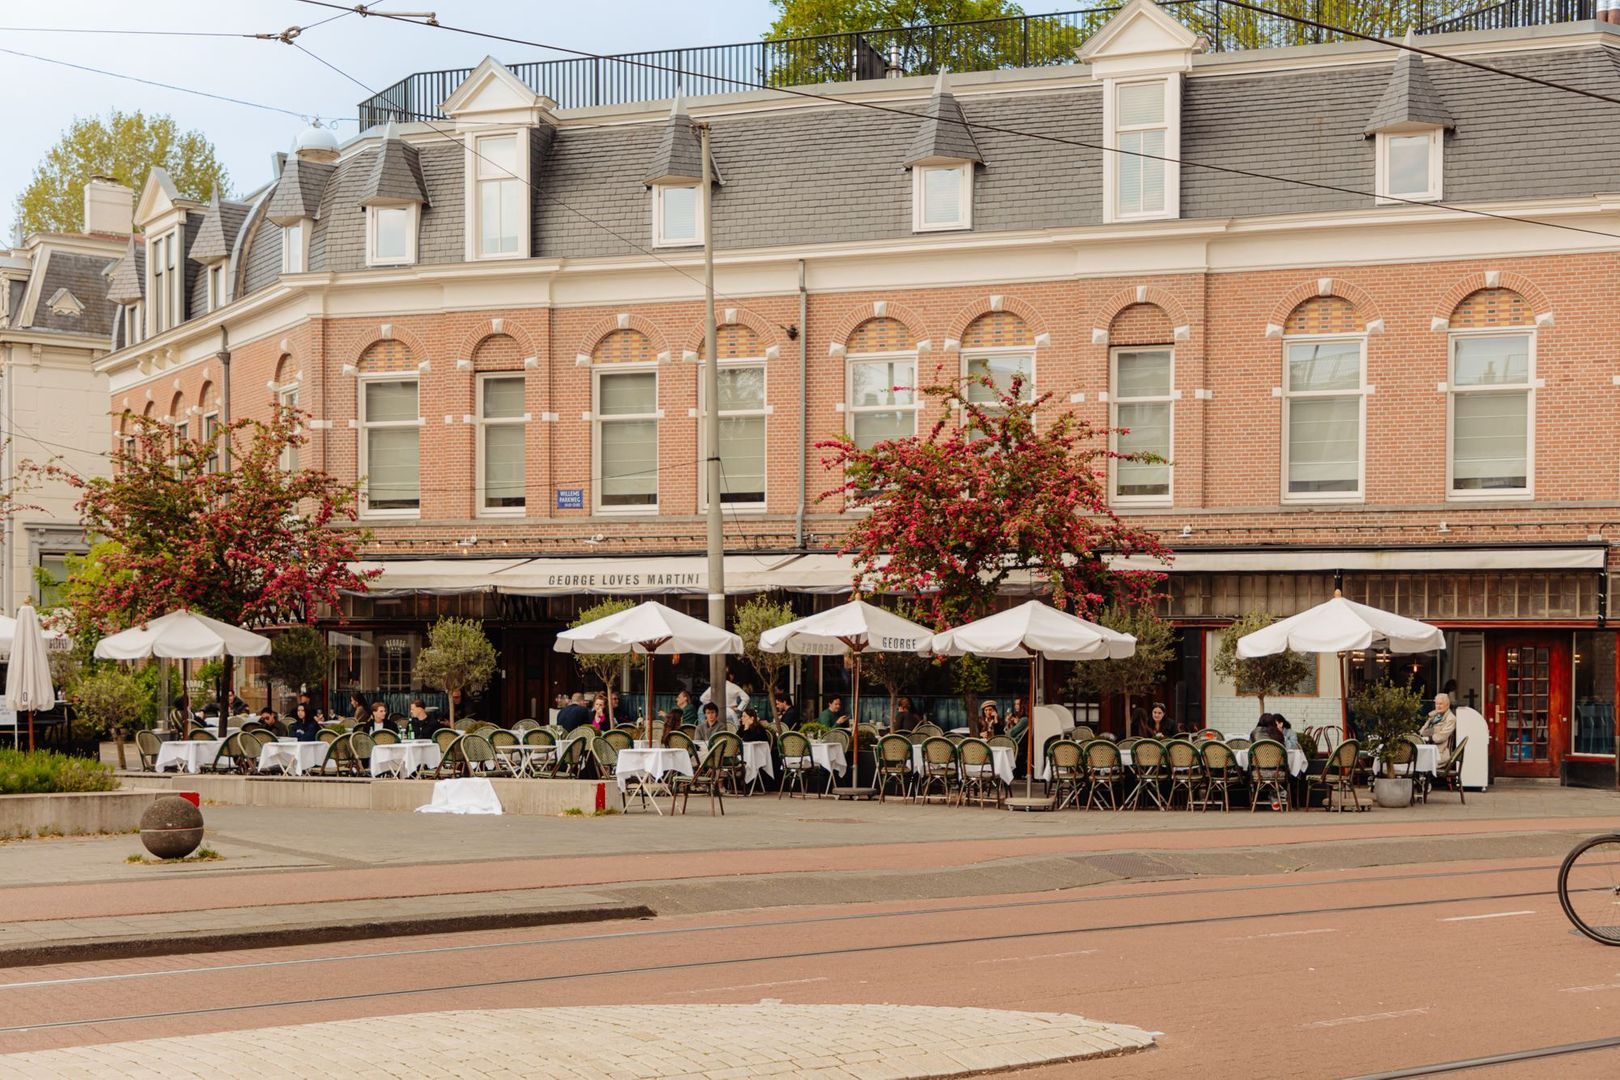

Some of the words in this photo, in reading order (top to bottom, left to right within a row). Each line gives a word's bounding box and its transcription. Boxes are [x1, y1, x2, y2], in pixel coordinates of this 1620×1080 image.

[548, 574, 595, 586] GEORGE
[602, 574, 640, 585] LOVES
[647, 573, 700, 585] MARTINI
[882, 637, 917, 649] GEORGE
